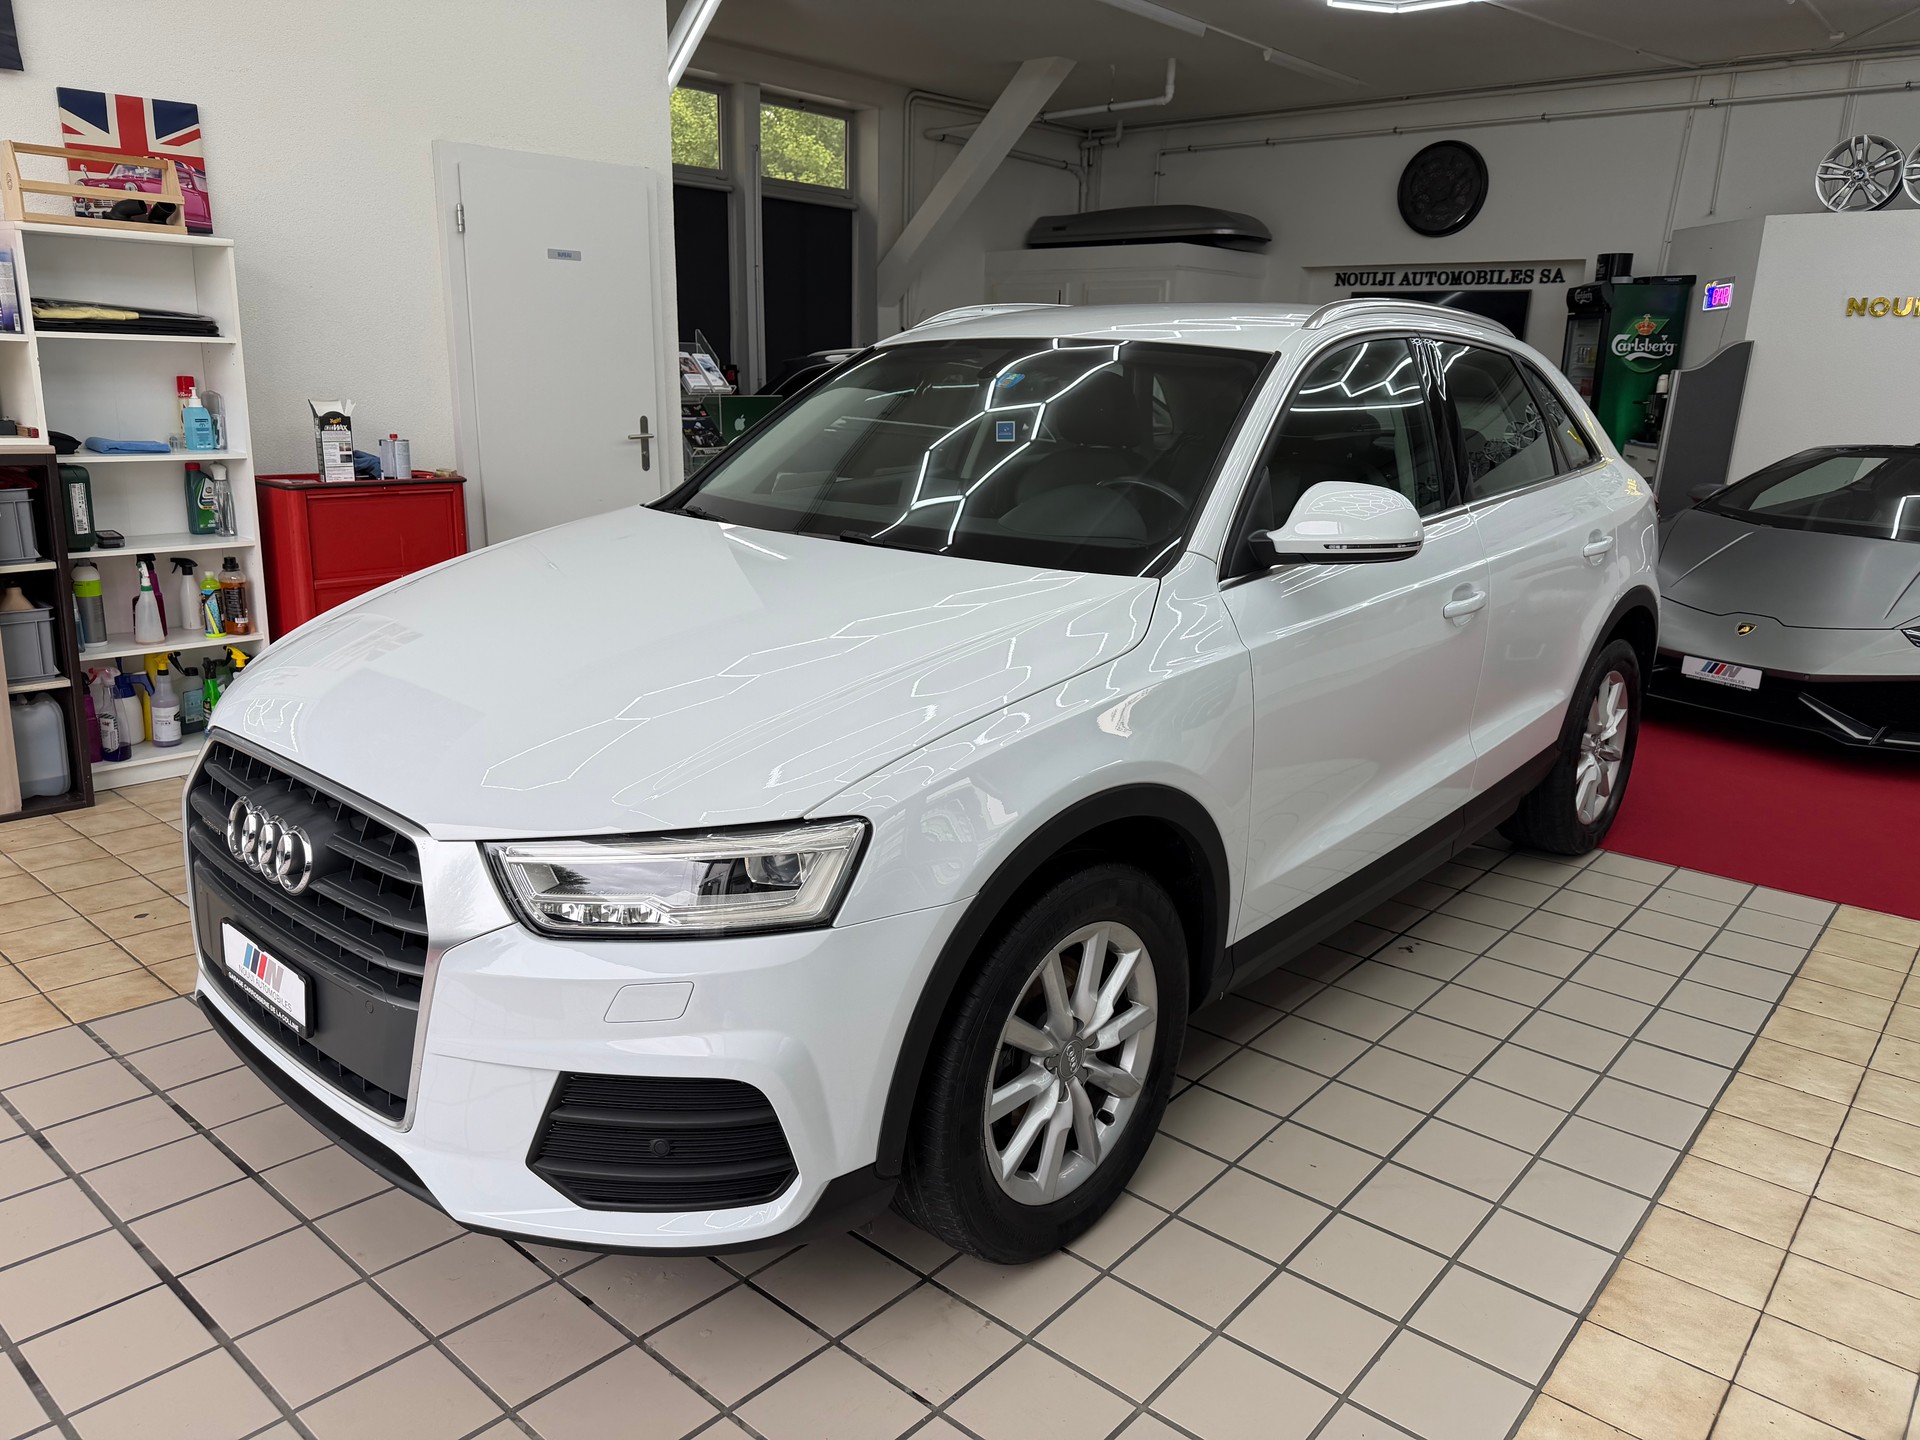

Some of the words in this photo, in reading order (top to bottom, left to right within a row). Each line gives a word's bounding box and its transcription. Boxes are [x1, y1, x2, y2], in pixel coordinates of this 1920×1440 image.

[1334, 271, 1396, 287] NOUIJI
[1398, 269, 1534, 287] AUTOMOBILES
[1539, 267, 1566, 284] SA
[1712, 286, 1730, 305] BAR
[1611, 334, 1675, 357] Carlsberg
[228, 971, 244, 988] GARAGE
[282, 1013, 300, 1033] COLLINE
[255, 978, 293, 1013] AUTOMOBILES
